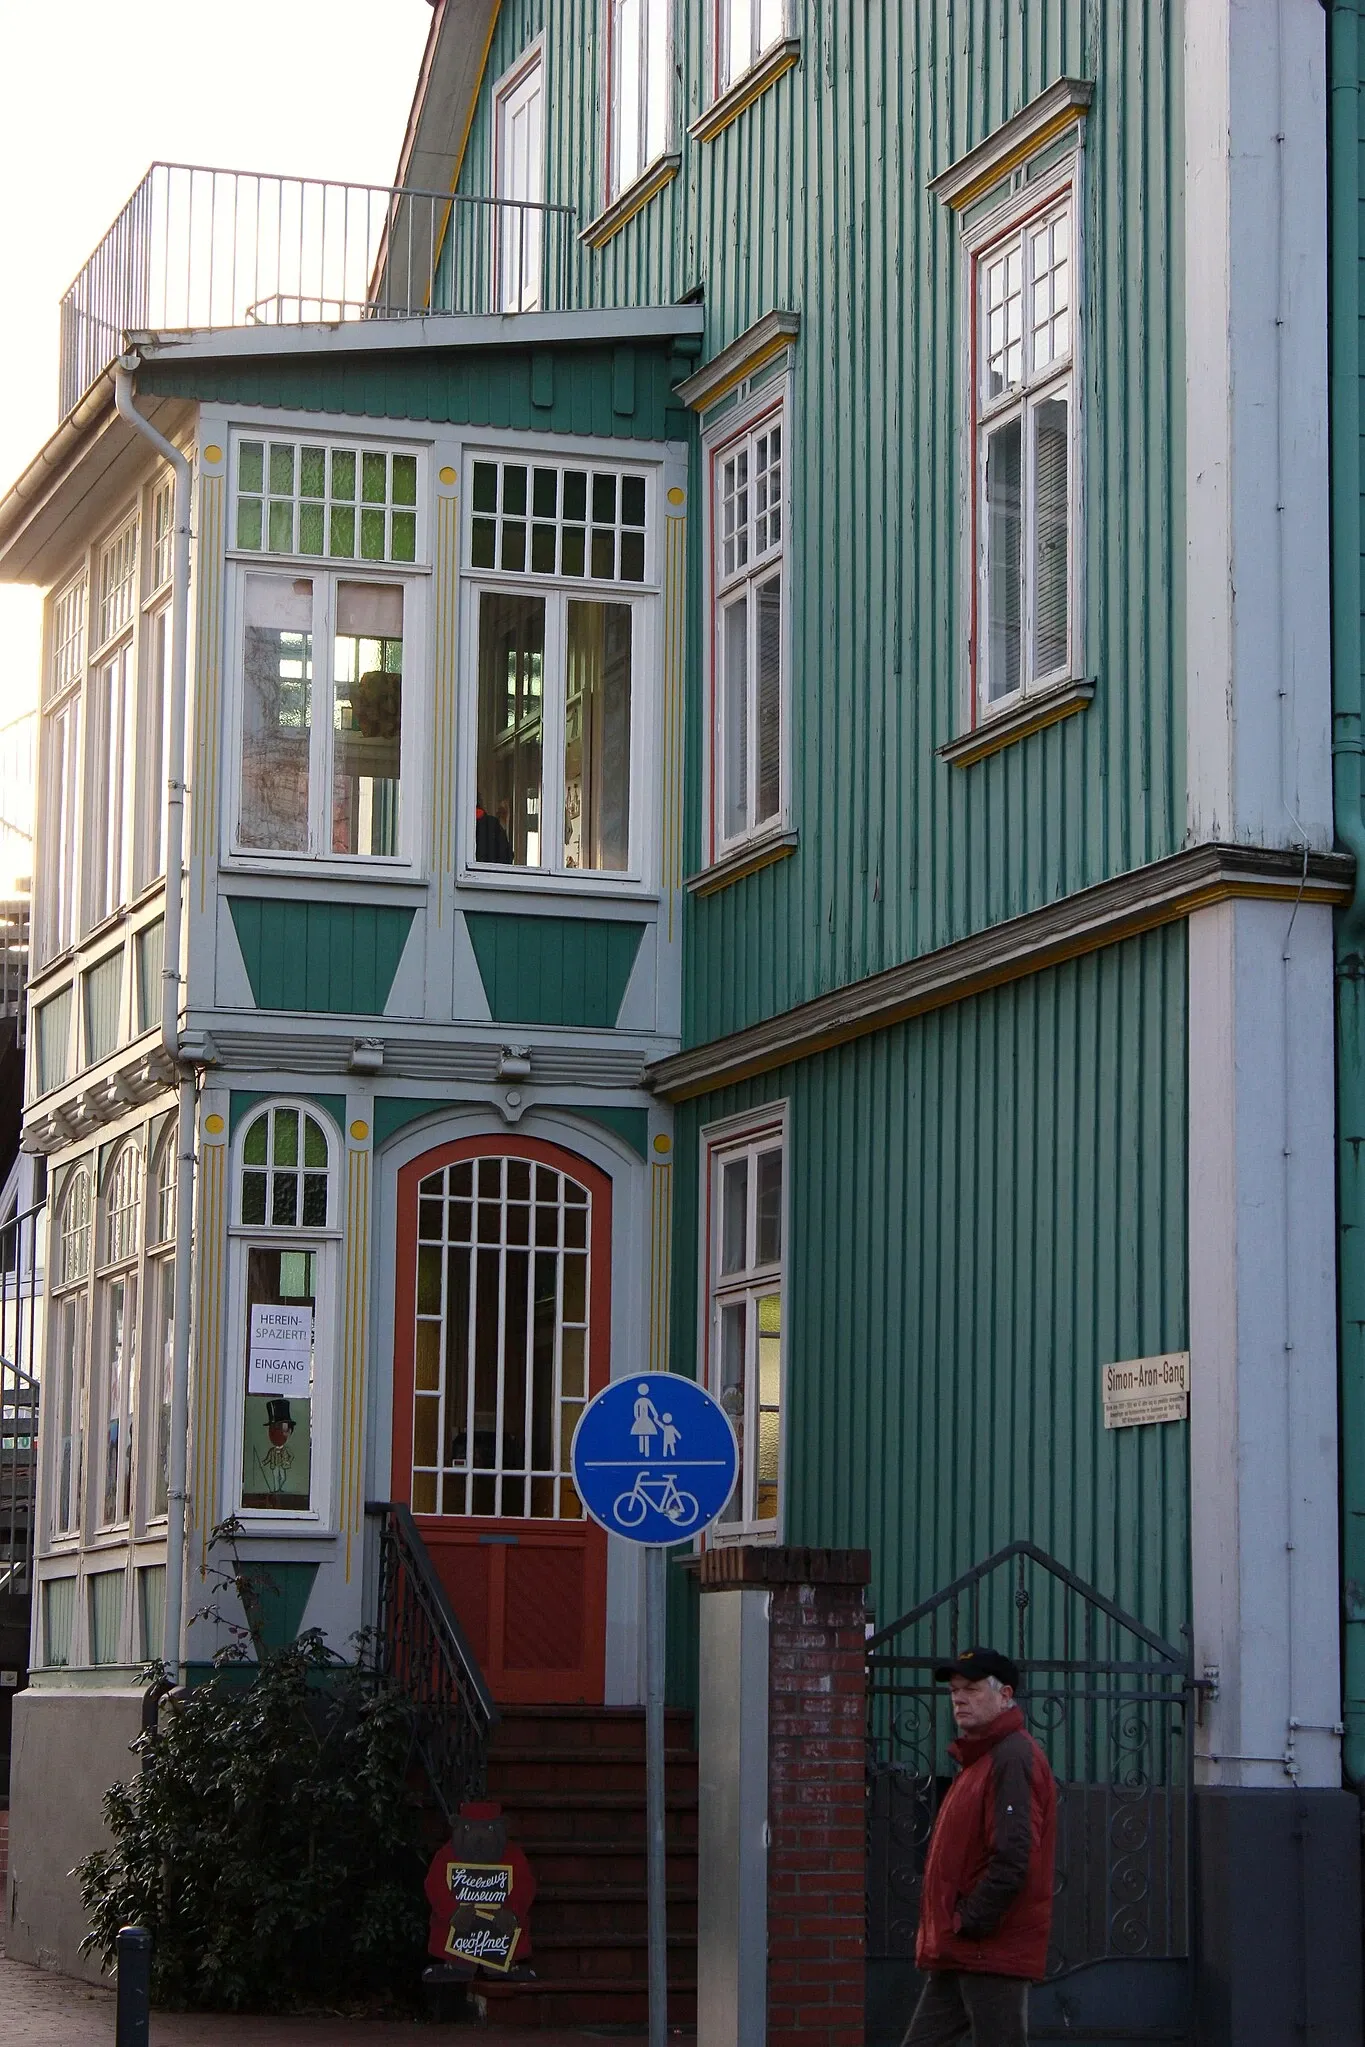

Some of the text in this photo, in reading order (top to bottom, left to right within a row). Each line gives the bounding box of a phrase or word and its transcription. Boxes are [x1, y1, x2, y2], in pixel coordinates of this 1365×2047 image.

[260, 1314, 302, 1326] HEREIN-
[255, 1328, 307, 1340] SPAZIERT!
[255, 1358, 304, 1371] EINGANG
[266, 1373, 293, 1384] HIER!
[1107, 1361, 1185, 1391] Simon-Aron-Gang
[455, 1887, 507, 1902] Museum
[453, 1930, 510, 1956] geöffnet
